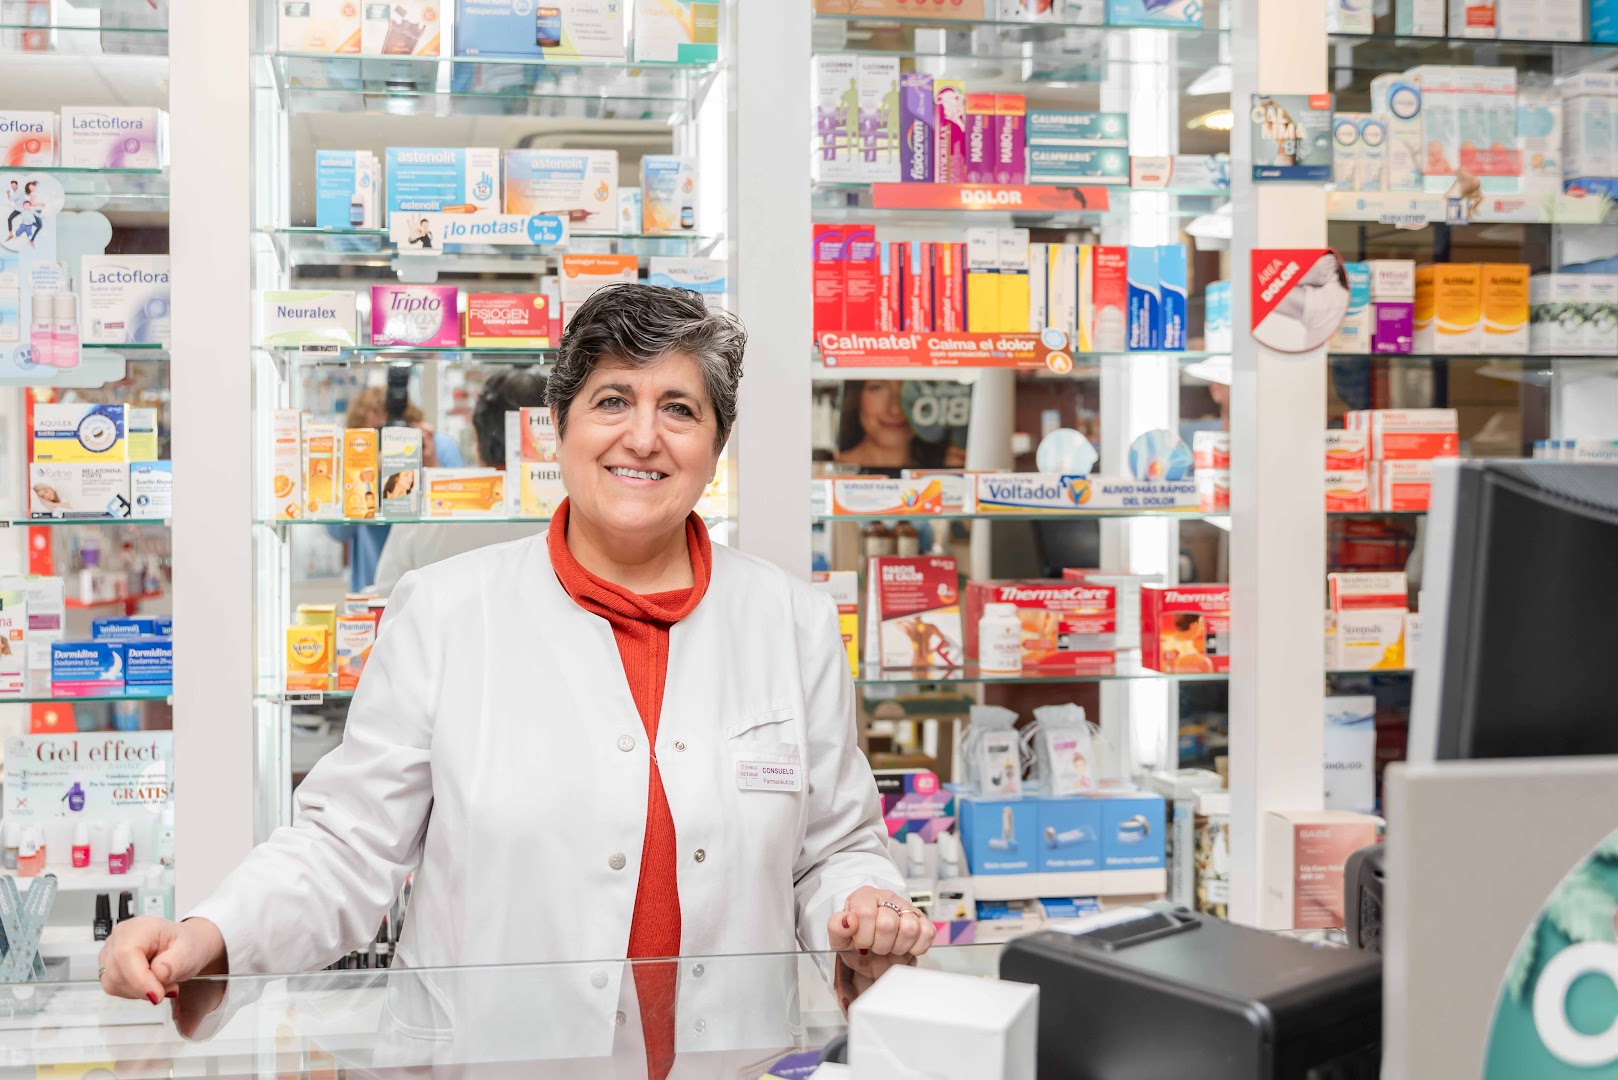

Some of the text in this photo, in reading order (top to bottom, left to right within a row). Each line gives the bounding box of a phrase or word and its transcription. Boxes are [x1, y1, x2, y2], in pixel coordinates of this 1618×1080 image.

[0, 120, 44, 133] oflora
[72, 117, 143, 130] Lactoflora
[910, 119, 924, 180] fisiocrem
[397, 151, 456, 163] astenolit
[531, 158, 583, 169] astenolit
[477, 185, 487, 194] 12
[960, 189, 1023, 204] DOLOR
[400, 201, 440, 211] astenolit
[469, 219, 526, 235] notas!
[533, 219, 558, 227] Tomar
[89, 270, 169, 284] Lactoflora
[1260, 260, 1300, 303] DOLOR
[390, 291, 441, 313] Tripto
[277, 306, 336, 319] Neuralex
[470, 308, 529, 319] FISIOGEN
[822, 333, 1036, 351] Calmatel Calma el dolor
[40, 420, 72, 428] AQUILEA
[989, 484, 1061, 499] Voltadol
[1102, 485, 1134, 494] ALIVIO
[1160, 483, 1196, 494] RÁPIDO
[1123, 497, 1175, 505] DEL DOLOR
[937, 583, 949, 596] 8
[1000, 587, 1110, 600] ThermaCare
[1164, 591, 1229, 603] ThermaC
[340, 623, 373, 631] Pharmaton
[1343, 624, 1382, 634] Strepsils
[129, 648, 172, 658] Dormidina
[292, 642, 323, 654] Supradyn
[54, 650, 98, 659] Dormidina
[37, 740, 160, 763] Gel effect
[762, 767, 794, 776] CONSUELO
[113, 786, 169, 799] GRATIS
